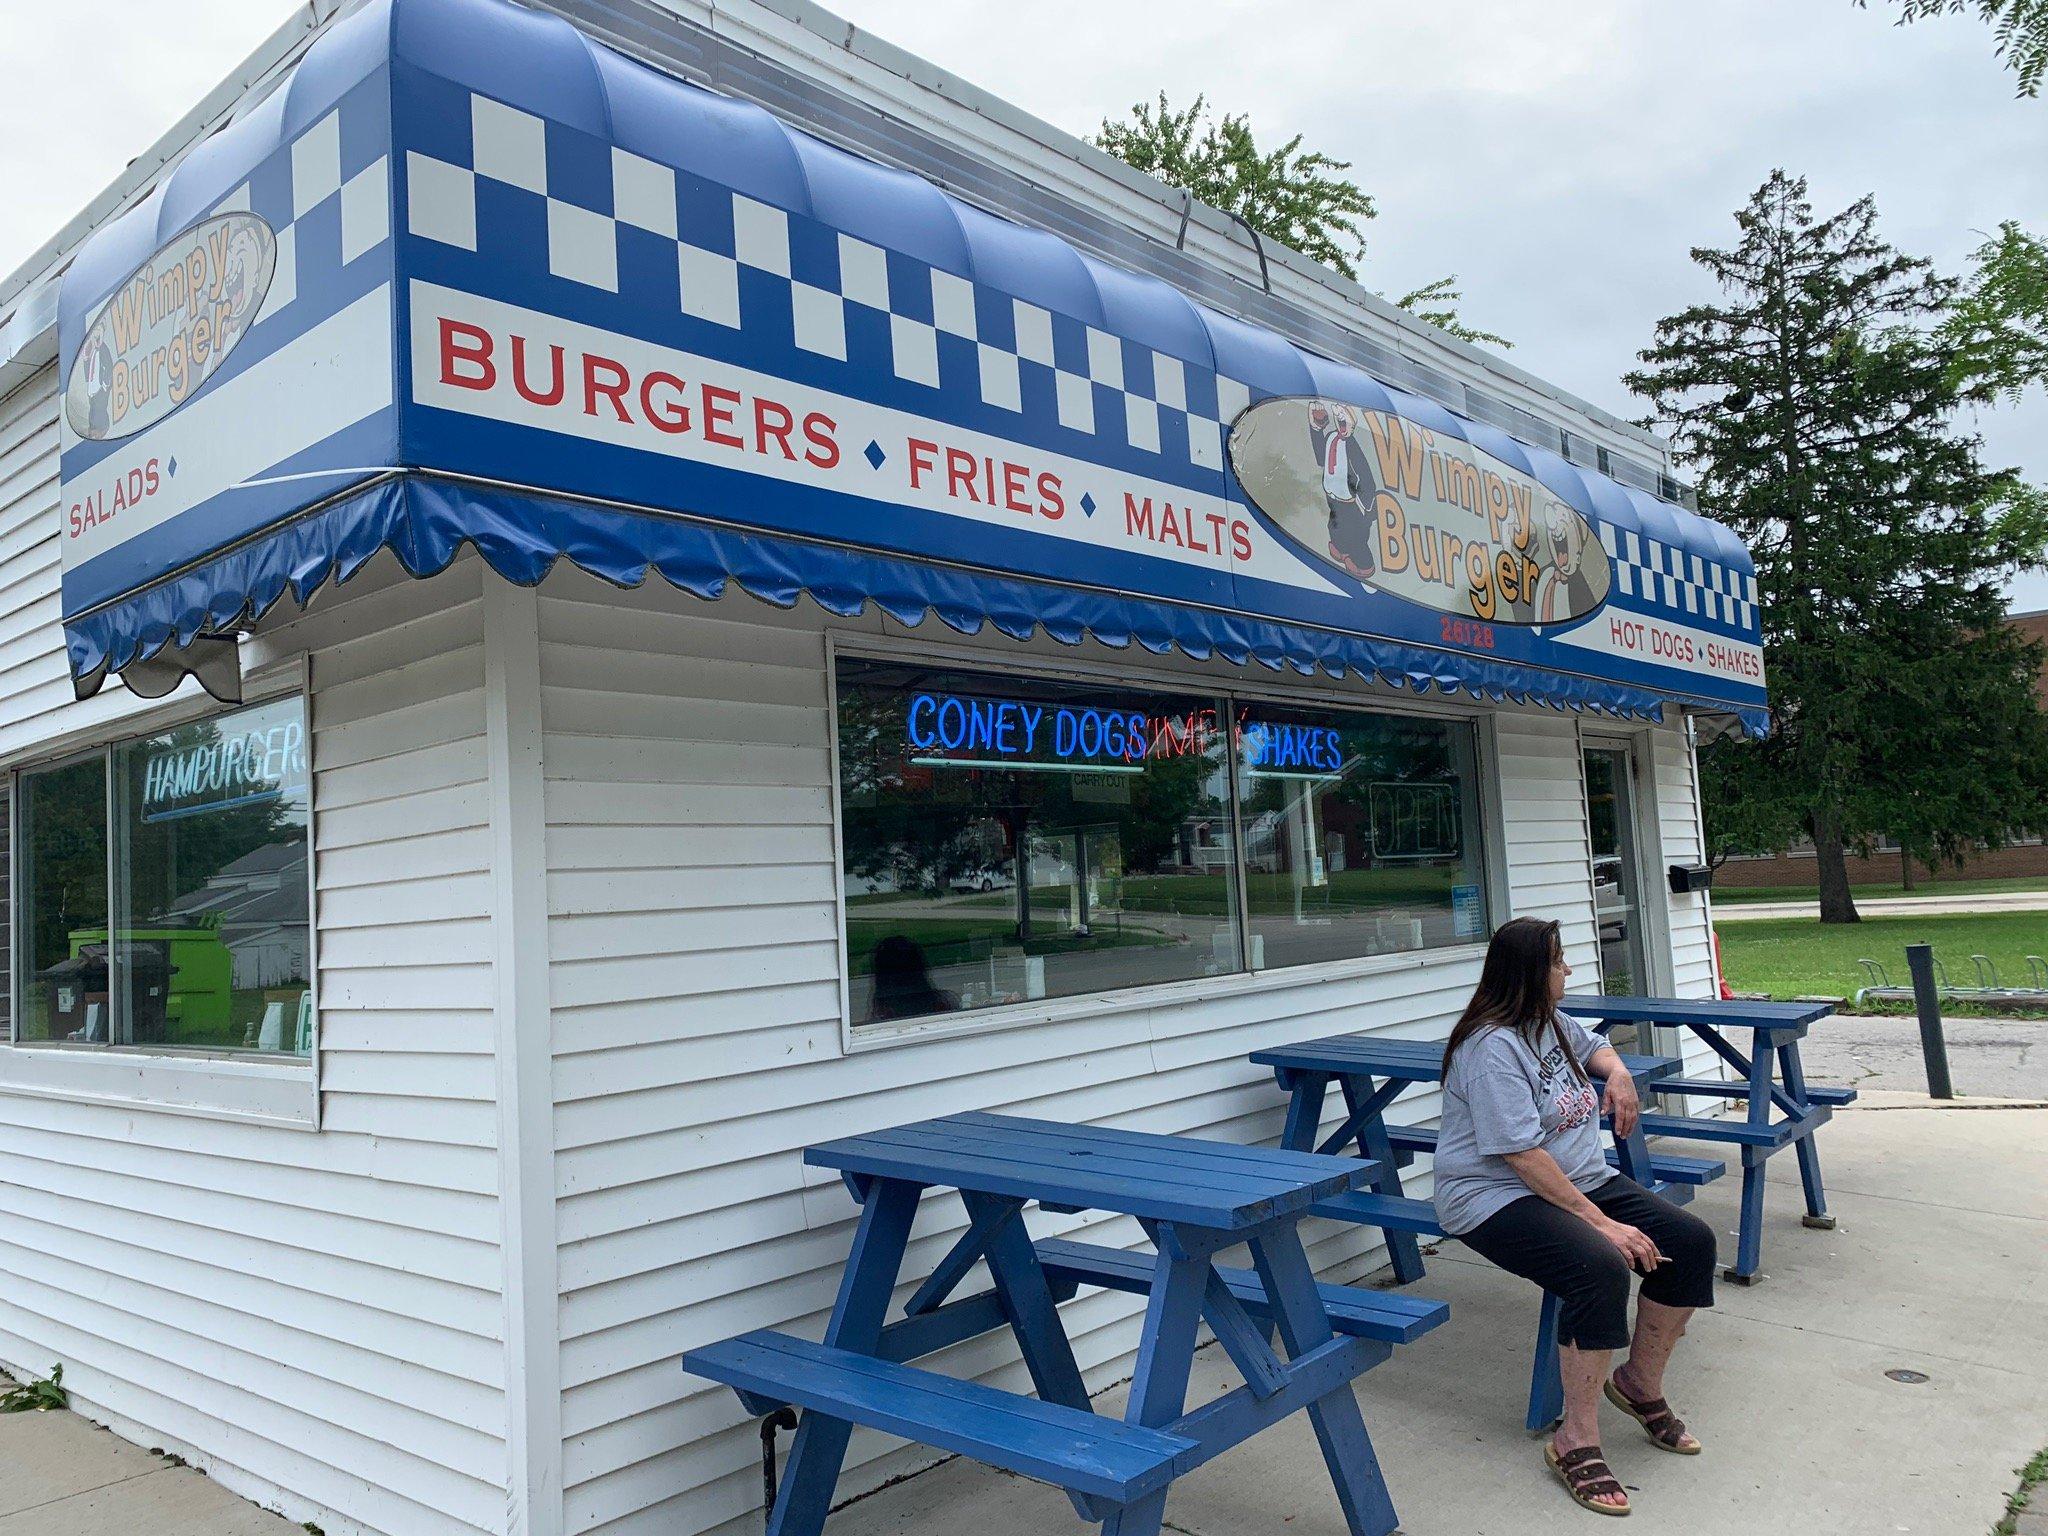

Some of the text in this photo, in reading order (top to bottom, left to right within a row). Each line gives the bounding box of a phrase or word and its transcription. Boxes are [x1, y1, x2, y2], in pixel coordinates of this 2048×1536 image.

[111, 221, 231, 356] Wimpy
[111, 300, 232, 425] Burger
[437, 317, 1253, 562] BURGERS FRIES MALTS
[1363, 408, 1532, 551] Wimpy
[68, 458, 160, 539] SALADS
[1375, 489, 1540, 621] Burger
[1610, 617, 1760, 678] HOT DOGS SHAKES
[144, 721, 307, 804] HAMBURGER
[908, 695, 1148, 758] CONEY DOGS
[1248, 721, 1343, 769] SHAKES
